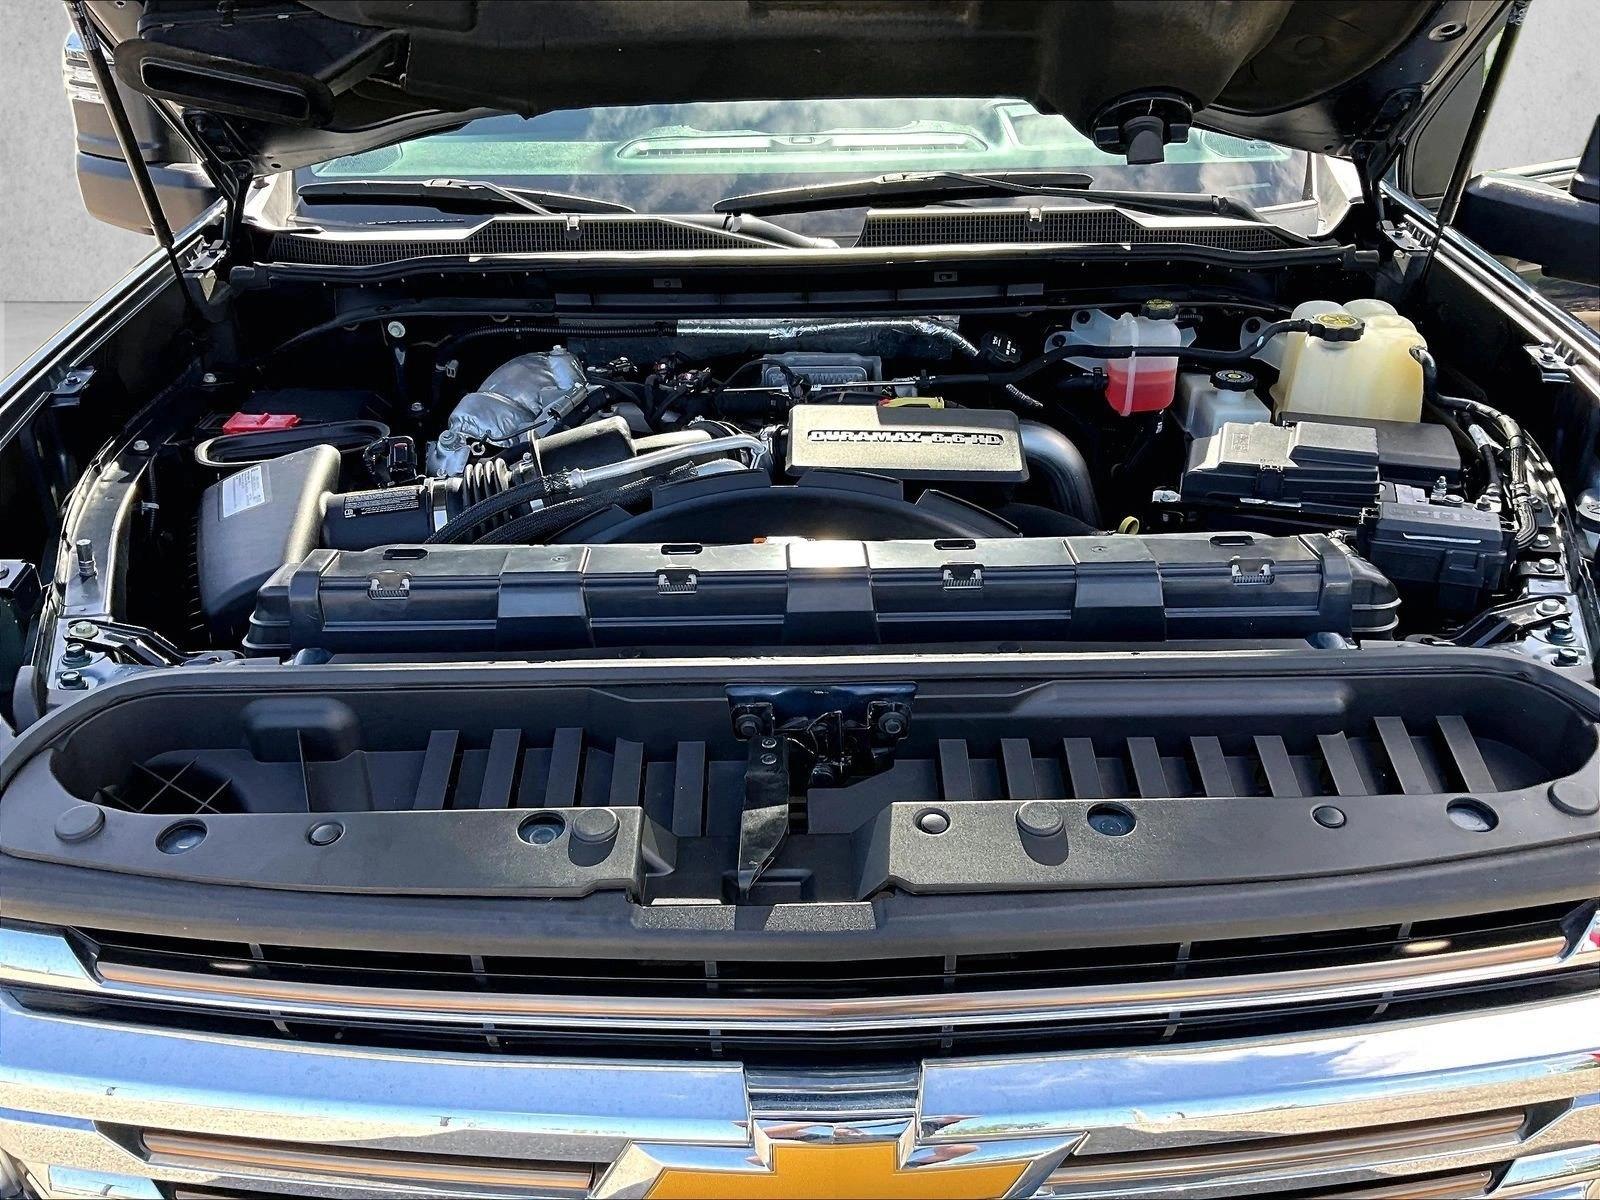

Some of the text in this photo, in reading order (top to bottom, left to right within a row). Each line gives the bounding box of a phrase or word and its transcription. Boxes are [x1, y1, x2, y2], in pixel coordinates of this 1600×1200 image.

[808, 431, 1002, 445] DURAMAX 6.6 HD
